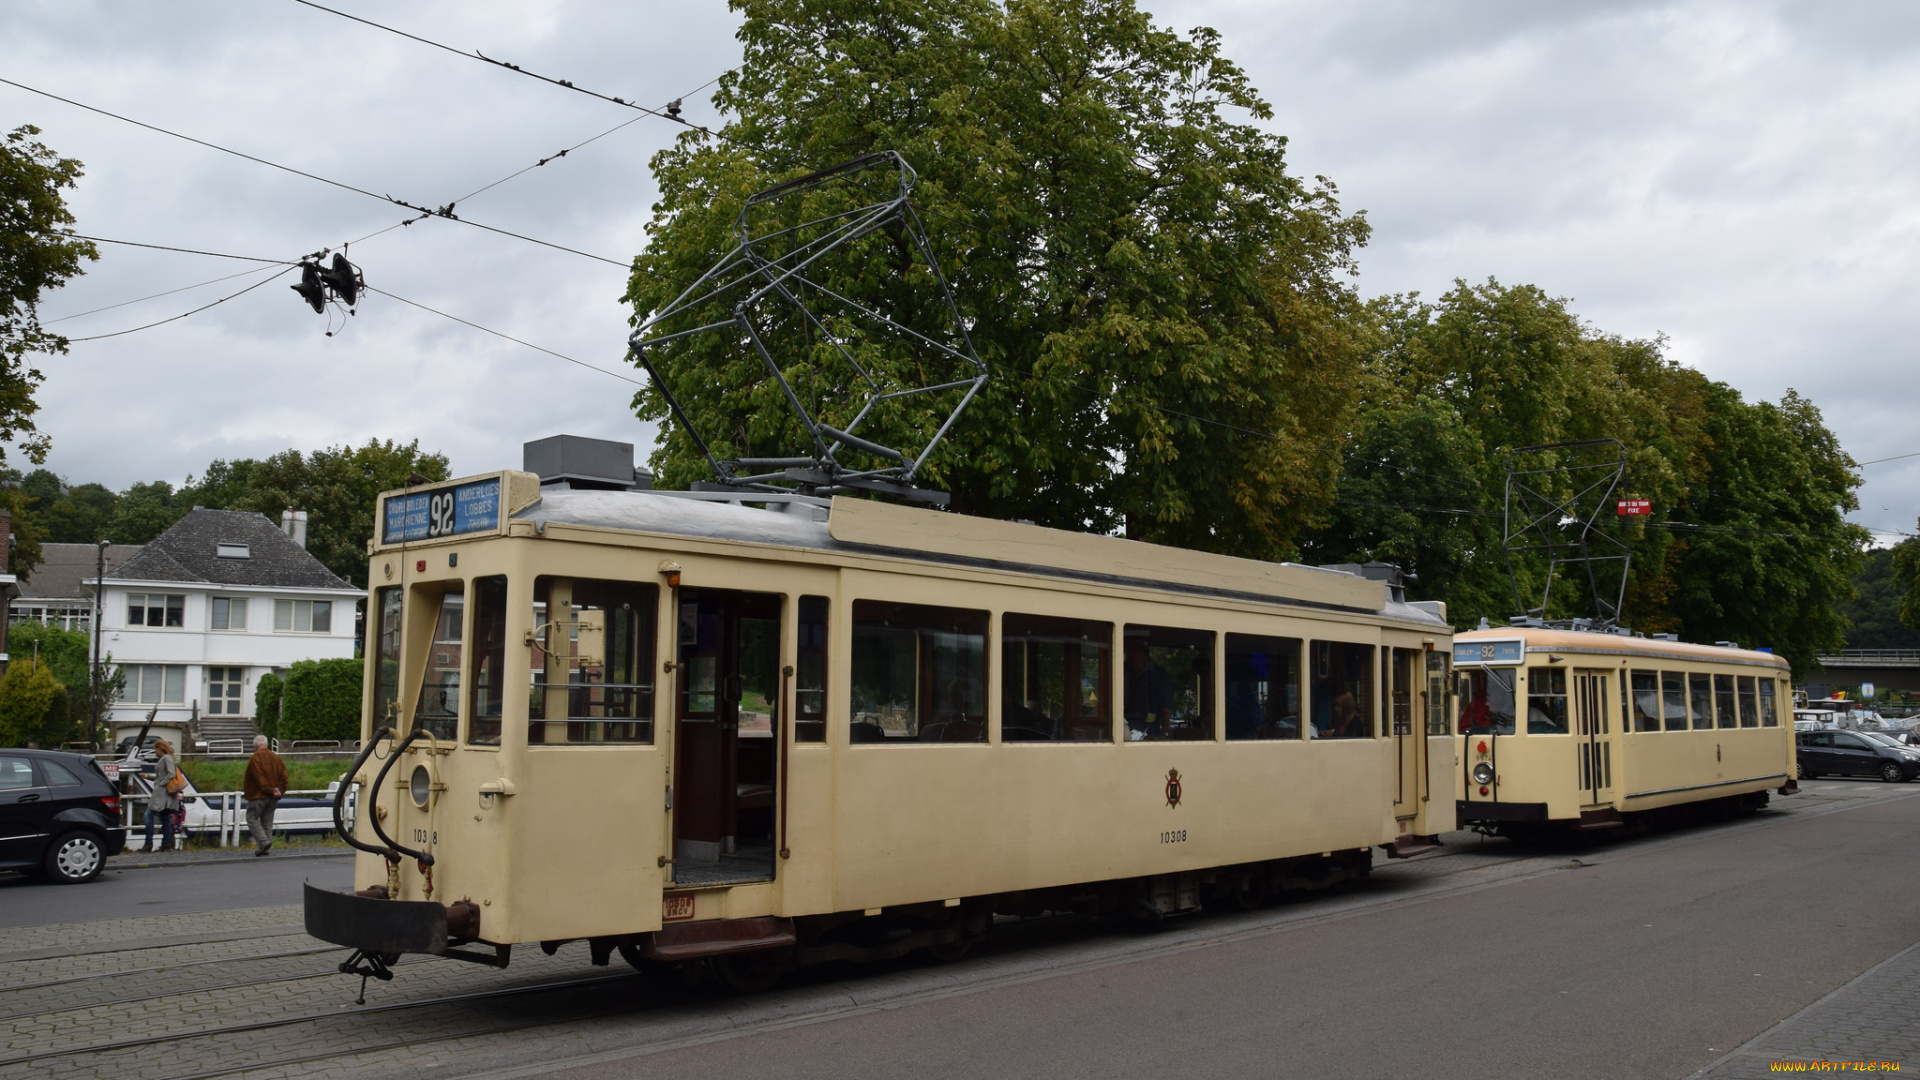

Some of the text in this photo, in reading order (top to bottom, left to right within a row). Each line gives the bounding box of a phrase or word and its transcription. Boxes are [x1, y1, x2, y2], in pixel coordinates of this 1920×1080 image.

[459, 483, 500, 502] ANDERLUES
[430, 493, 454, 537] 92
[464, 501, 492, 517] LOBBES
[1482, 646, 1495, 658] 92
[414, 828, 438, 845] 1038
[1160, 829, 1187, 844] 10308
[665, 898, 691, 909] 10308
[667, 908, 688, 916] SNCV
